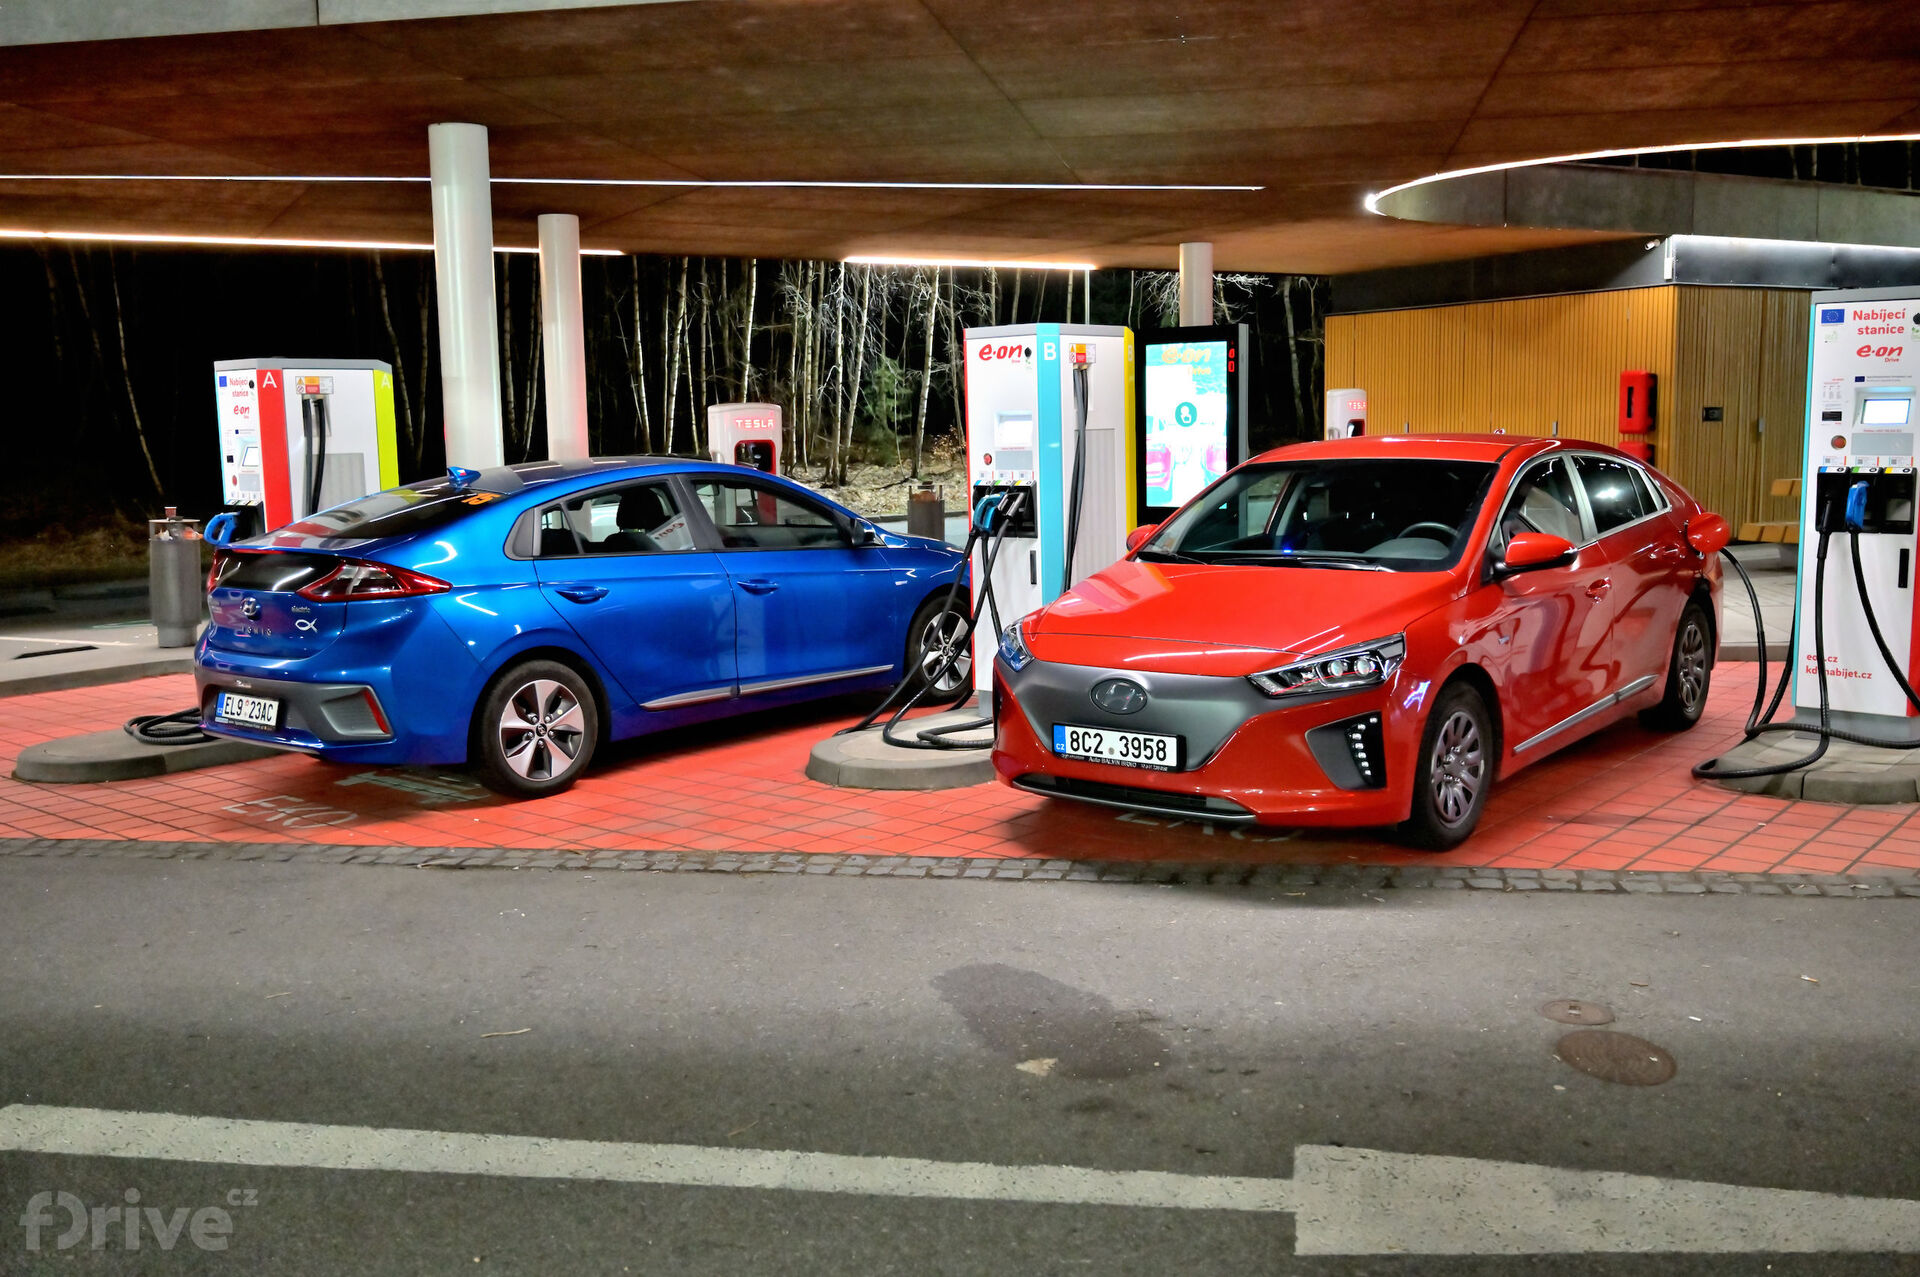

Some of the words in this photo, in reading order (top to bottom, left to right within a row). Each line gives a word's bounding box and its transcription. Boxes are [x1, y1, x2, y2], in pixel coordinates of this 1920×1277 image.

[1852, 308, 1906, 322] Nabíjecí
[1857, 324, 1905, 335] stanice
[1043, 342, 1057, 360] B
[262, 371, 278, 388] A
[381, 373, 392, 389] A
[735, 419, 774, 428] TESLA
[1806, 654, 1838, 663] eo.cz
[1805, 665, 1872, 679] kdnabijet.cz
[224, 696, 244, 716] EL9
[248, 700, 274, 722] 23AC
[1055, 743, 1065, 751] CZ
[1069, 730, 1104, 755] 8C2
[1119, 735, 1167, 761] 3958
